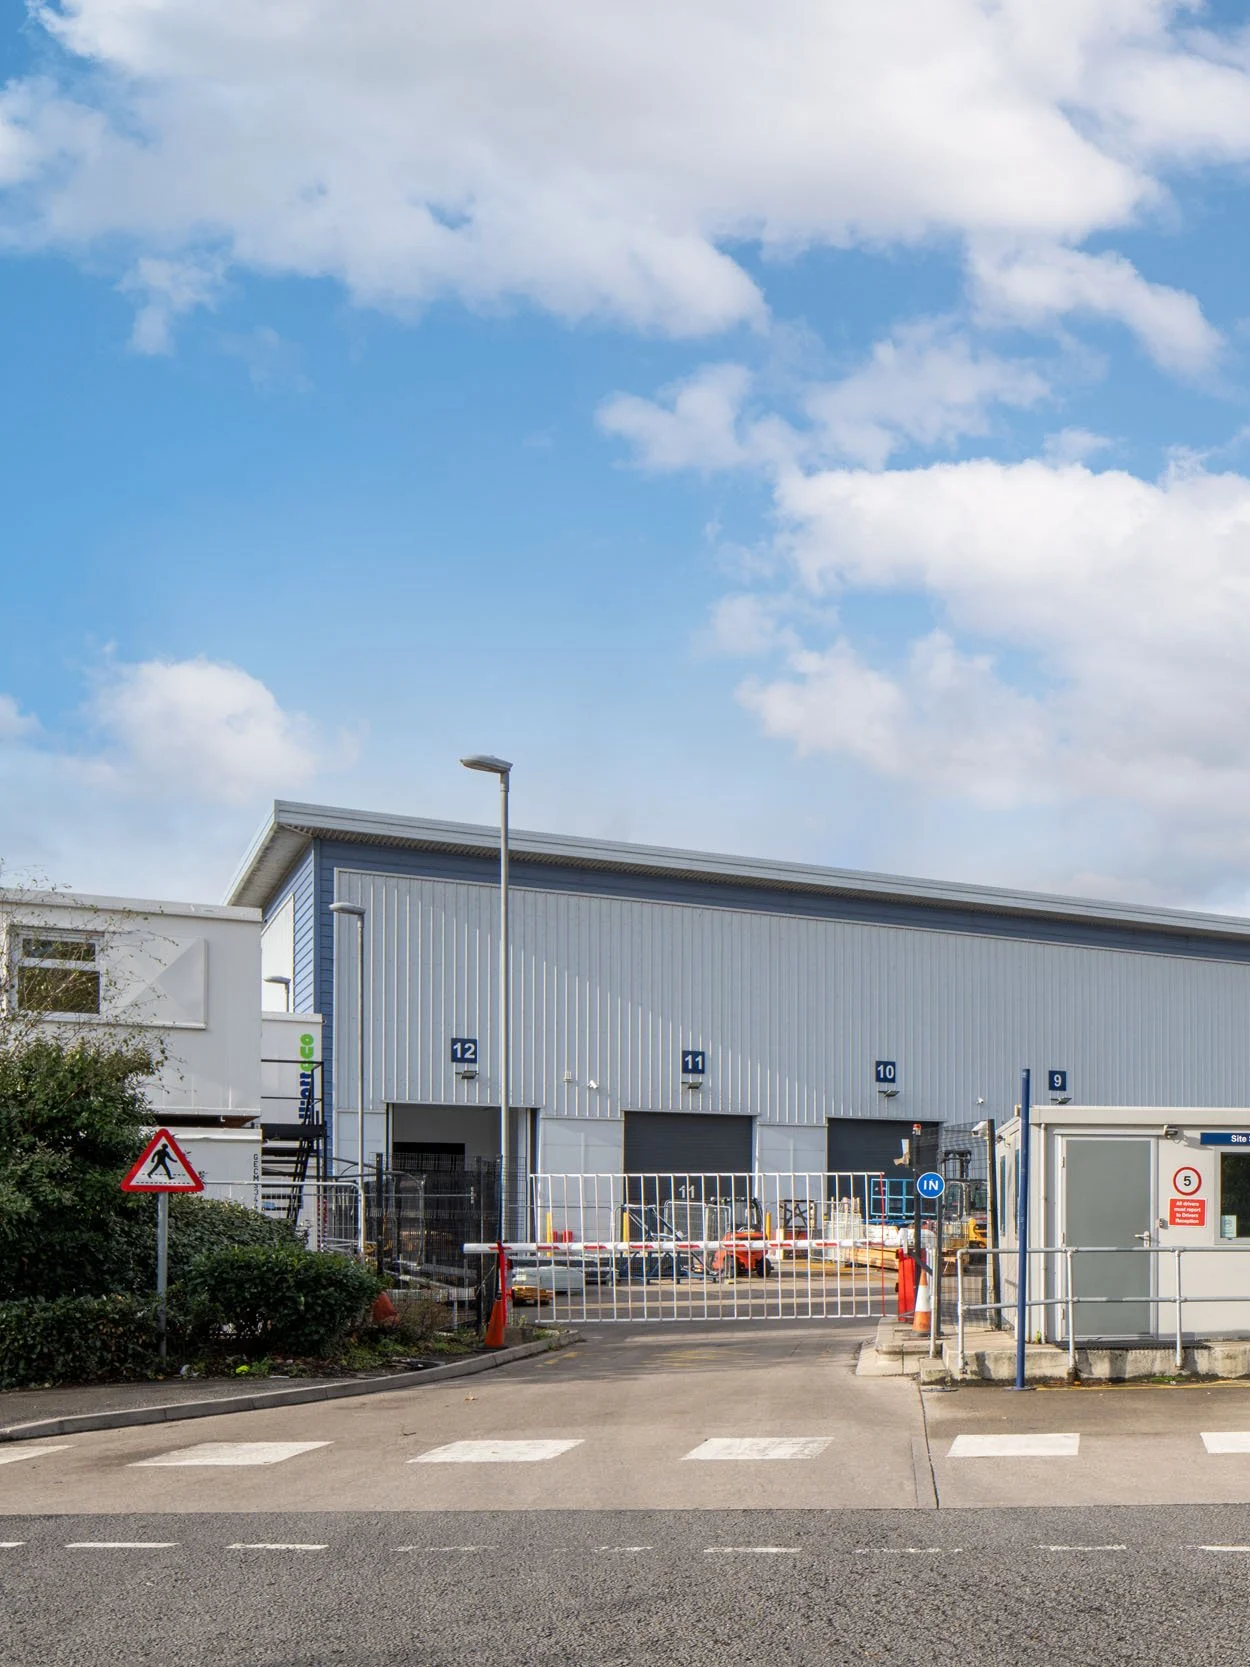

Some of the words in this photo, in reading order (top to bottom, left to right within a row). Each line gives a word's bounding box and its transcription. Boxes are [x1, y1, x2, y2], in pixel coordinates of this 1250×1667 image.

[453, 1042, 475, 1058] 12
[684, 1054, 702, 1070] 11
[877, 1064, 894, 1079] 10
[1054, 1074, 1061, 1087] 9
[1231, 1134, 1247, 1143] Site
[923, 1179, 939, 1191] IN
[1183, 1175, 1192, 1187] 5
[679, 1185, 695, 1198] 11
